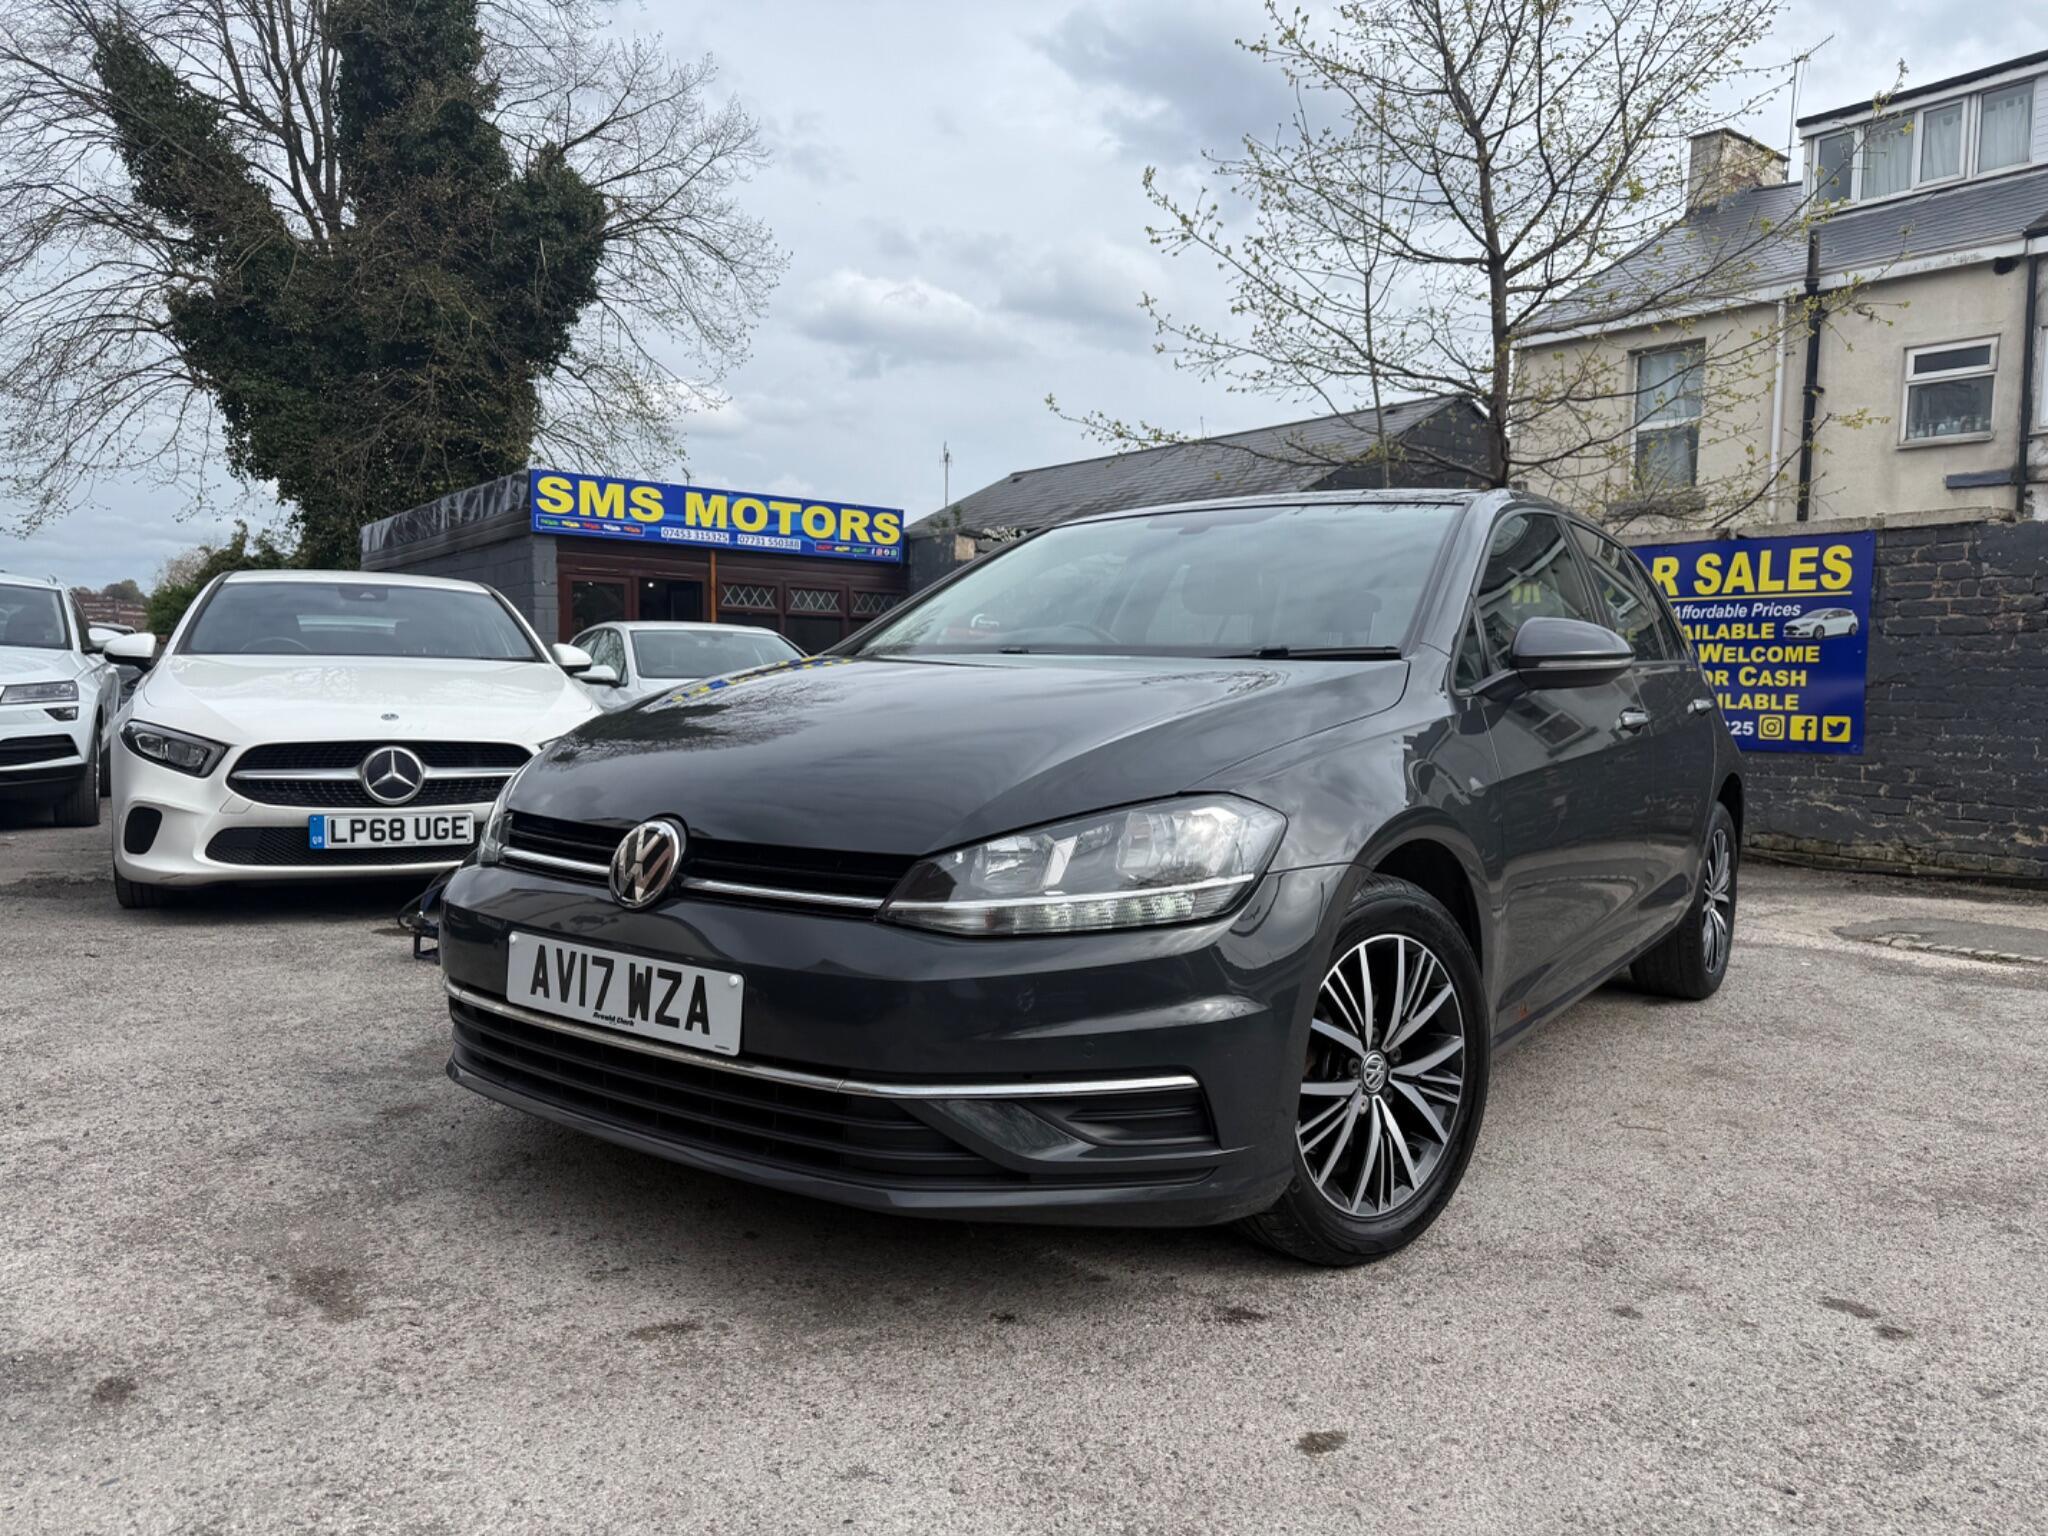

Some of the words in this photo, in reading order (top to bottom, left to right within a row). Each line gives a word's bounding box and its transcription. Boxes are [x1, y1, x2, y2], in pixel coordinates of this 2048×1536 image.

[536, 476, 665, 522] SMS
[685, 491, 901, 545] MOTORS
[1693, 544, 1853, 595] SALES
[1752, 602, 1802, 618] Prices
[1698, 643, 1820, 663] WELCOME
[1738, 666, 1807, 687] CASH
[330, 818, 406, 843] LP68
[414, 816, 468, 841] UGE
[530, 945, 615, 1011] AV17
[627, 963, 710, 1035] WZA
